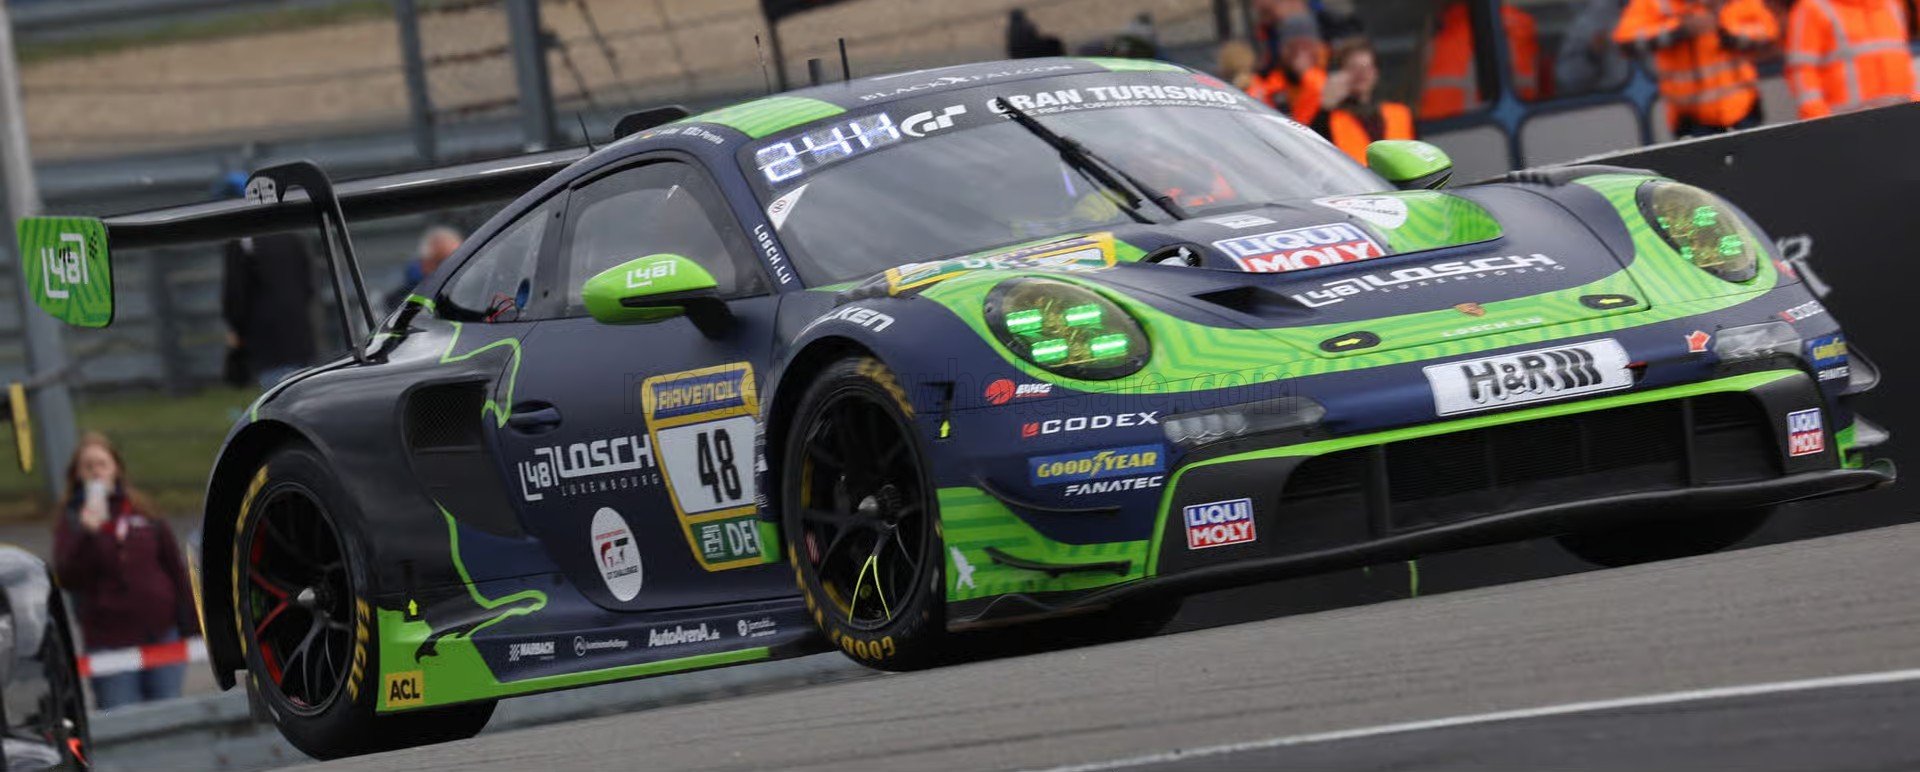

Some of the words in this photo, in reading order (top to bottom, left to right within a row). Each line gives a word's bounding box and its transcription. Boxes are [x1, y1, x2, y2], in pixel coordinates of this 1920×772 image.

[986, 88, 1083, 114] GRAN
[1086, 85, 1238, 104] TURISMO
[753, 223, 792, 285] LOSCH.LU
[1225, 222, 1364, 257] LIQUI
[1249, 241, 1379, 273] MOLY
[1363, 253, 1557, 287] LOSCH
[1041, 410, 1160, 435] CODEX
[555, 434, 656, 479] LOSCH
[696, 428, 742, 504] 48
[561, 473, 660, 496] LUXEMBOURG
[1064, 475, 1164, 496] FANATEC
[1189, 502, 1249, 527] LIQUI
[1191, 521, 1252, 545] MOLY
[390, 679, 421, 700] ACL
